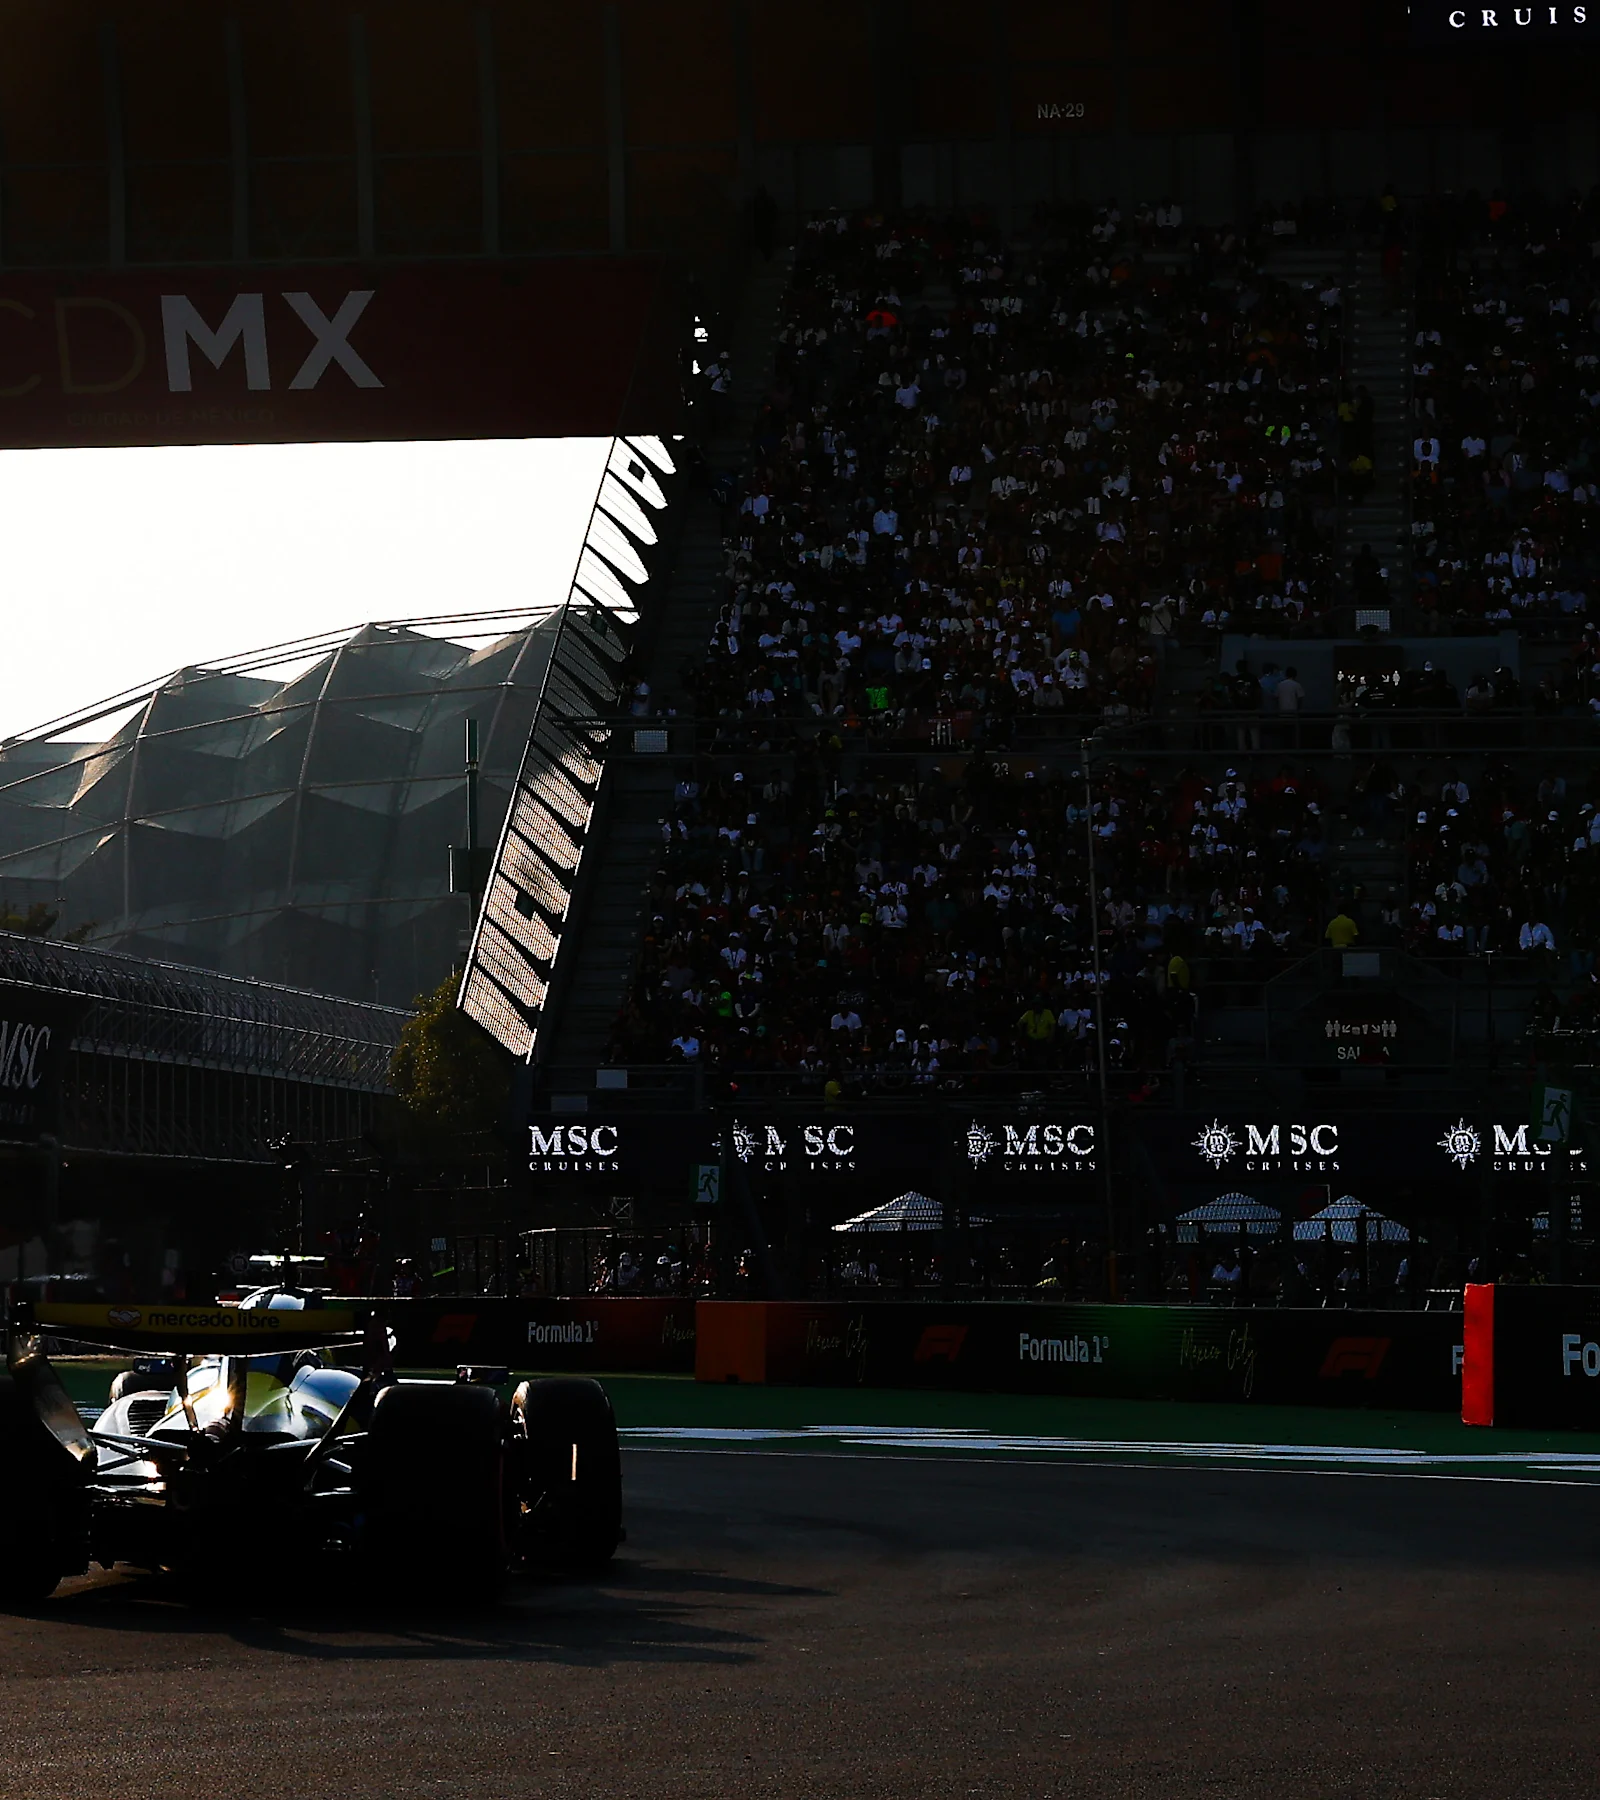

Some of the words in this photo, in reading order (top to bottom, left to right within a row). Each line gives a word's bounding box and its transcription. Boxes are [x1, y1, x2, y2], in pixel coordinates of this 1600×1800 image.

[528, 1125, 619, 1156] MSC
[1002, 1124, 1096, 1156] MSC
[1244, 1124, 1339, 1156] MSC
[147, 1311, 234, 1328] mercado
[238, 1312, 280, 1329] libre
[527, 1320, 583, 1344] Formula
[1018, 1332, 1089, 1363] Formula
